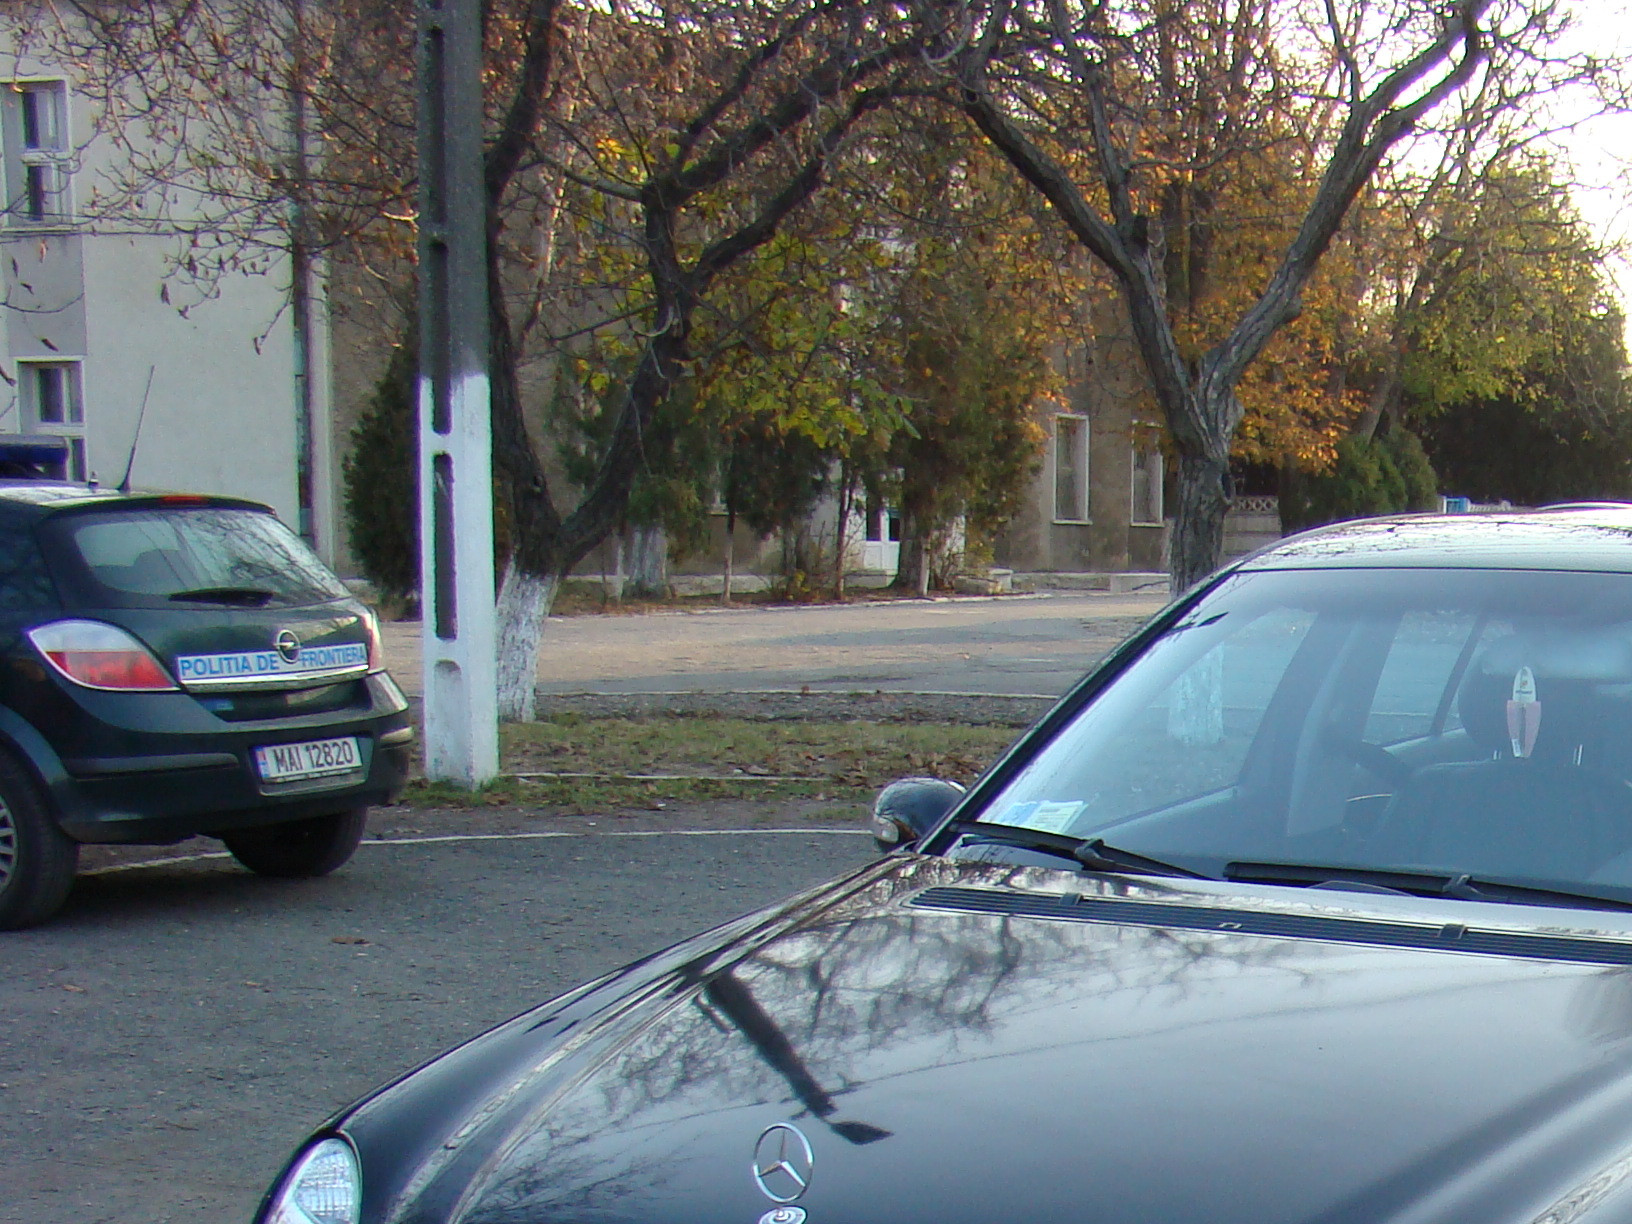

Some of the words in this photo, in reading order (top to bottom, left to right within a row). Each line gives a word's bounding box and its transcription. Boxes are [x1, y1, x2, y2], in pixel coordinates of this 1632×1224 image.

[181, 657, 253, 676] POLITIA
[256, 653, 280, 670] DE
[301, 647, 366, 667] FRONTIERA
[273, 746, 304, 773] MAI
[305, 740, 354, 769] 12820
